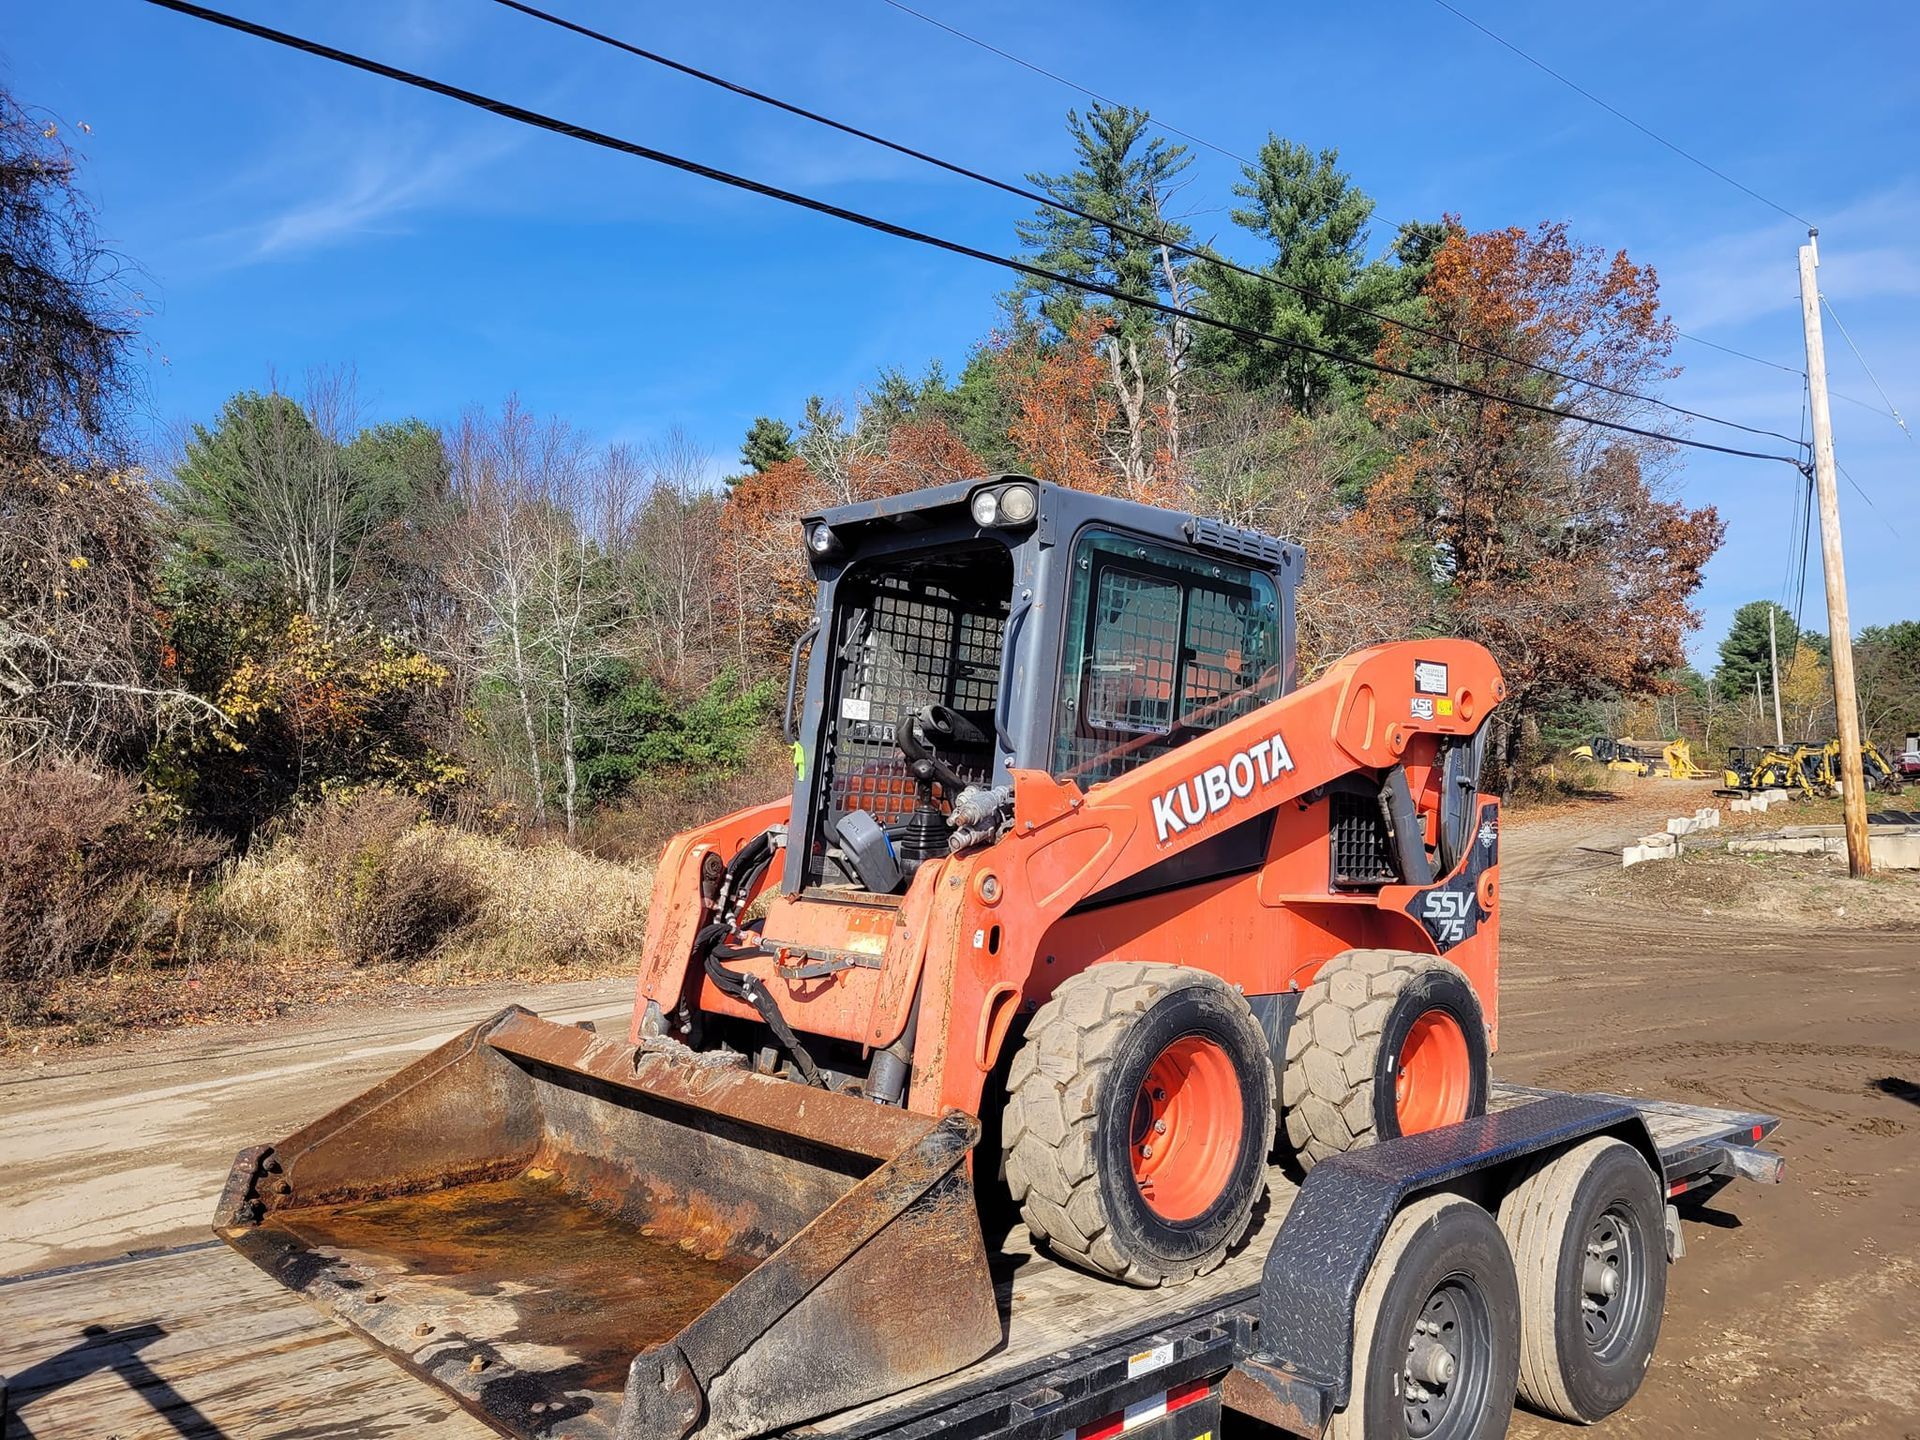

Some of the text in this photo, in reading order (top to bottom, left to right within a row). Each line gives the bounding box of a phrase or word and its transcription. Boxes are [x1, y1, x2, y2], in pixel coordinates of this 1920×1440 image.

[1411, 698, 1433, 711] KSR
[1151, 733, 1295, 842] KUBOTA
[1423, 891, 1476, 918] SSV
[1439, 919, 1465, 941] 75
